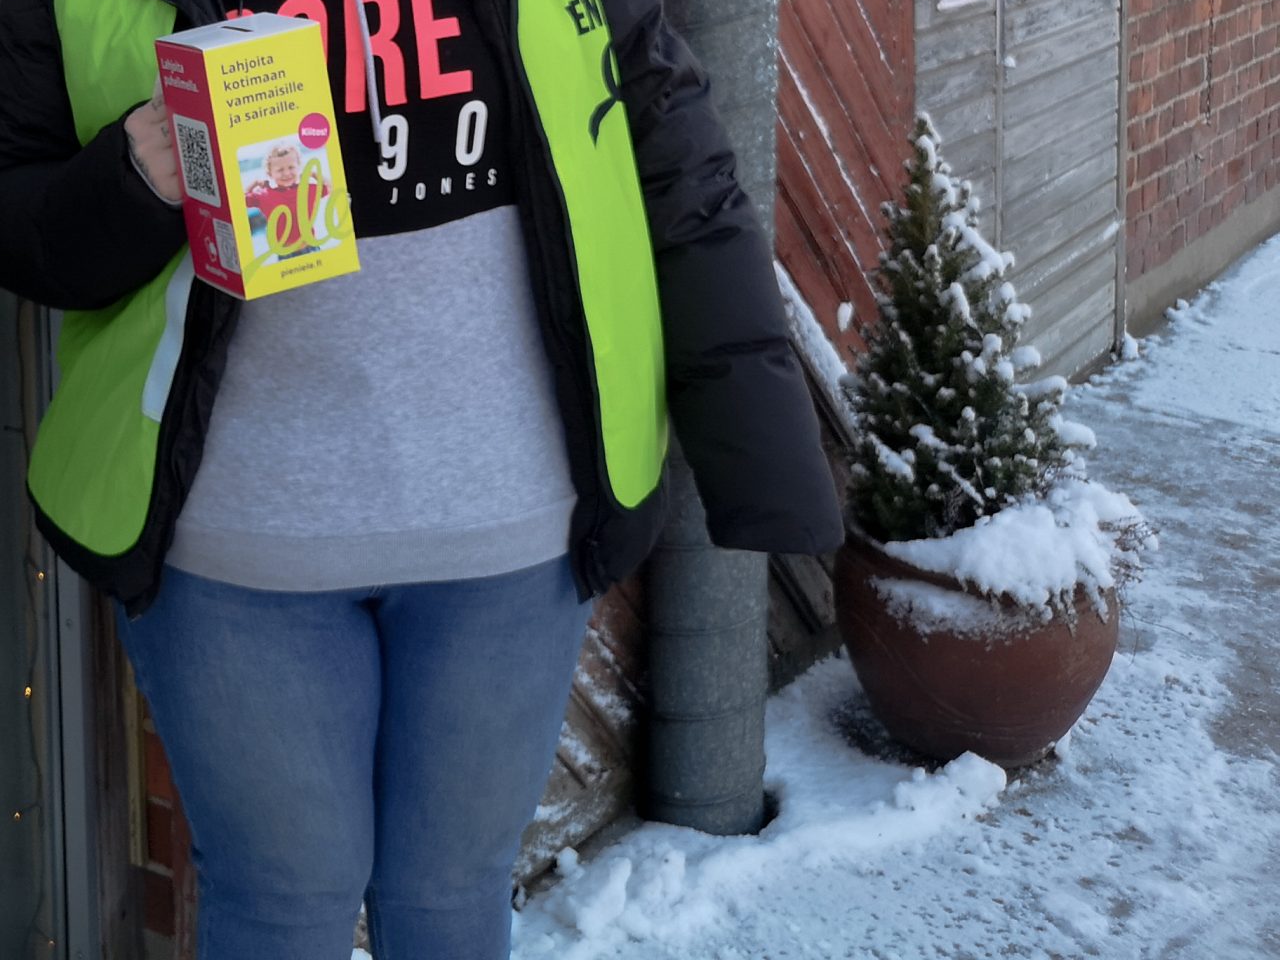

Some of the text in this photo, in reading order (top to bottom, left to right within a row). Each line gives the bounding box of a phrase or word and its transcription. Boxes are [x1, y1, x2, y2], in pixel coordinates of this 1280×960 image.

[221, 55, 274, 76] Lahjoita
[223, 69, 287, 92] kotimaan
[226, 81, 304, 108] vammaisille
[228, 101, 299, 128] ja sairaille.
